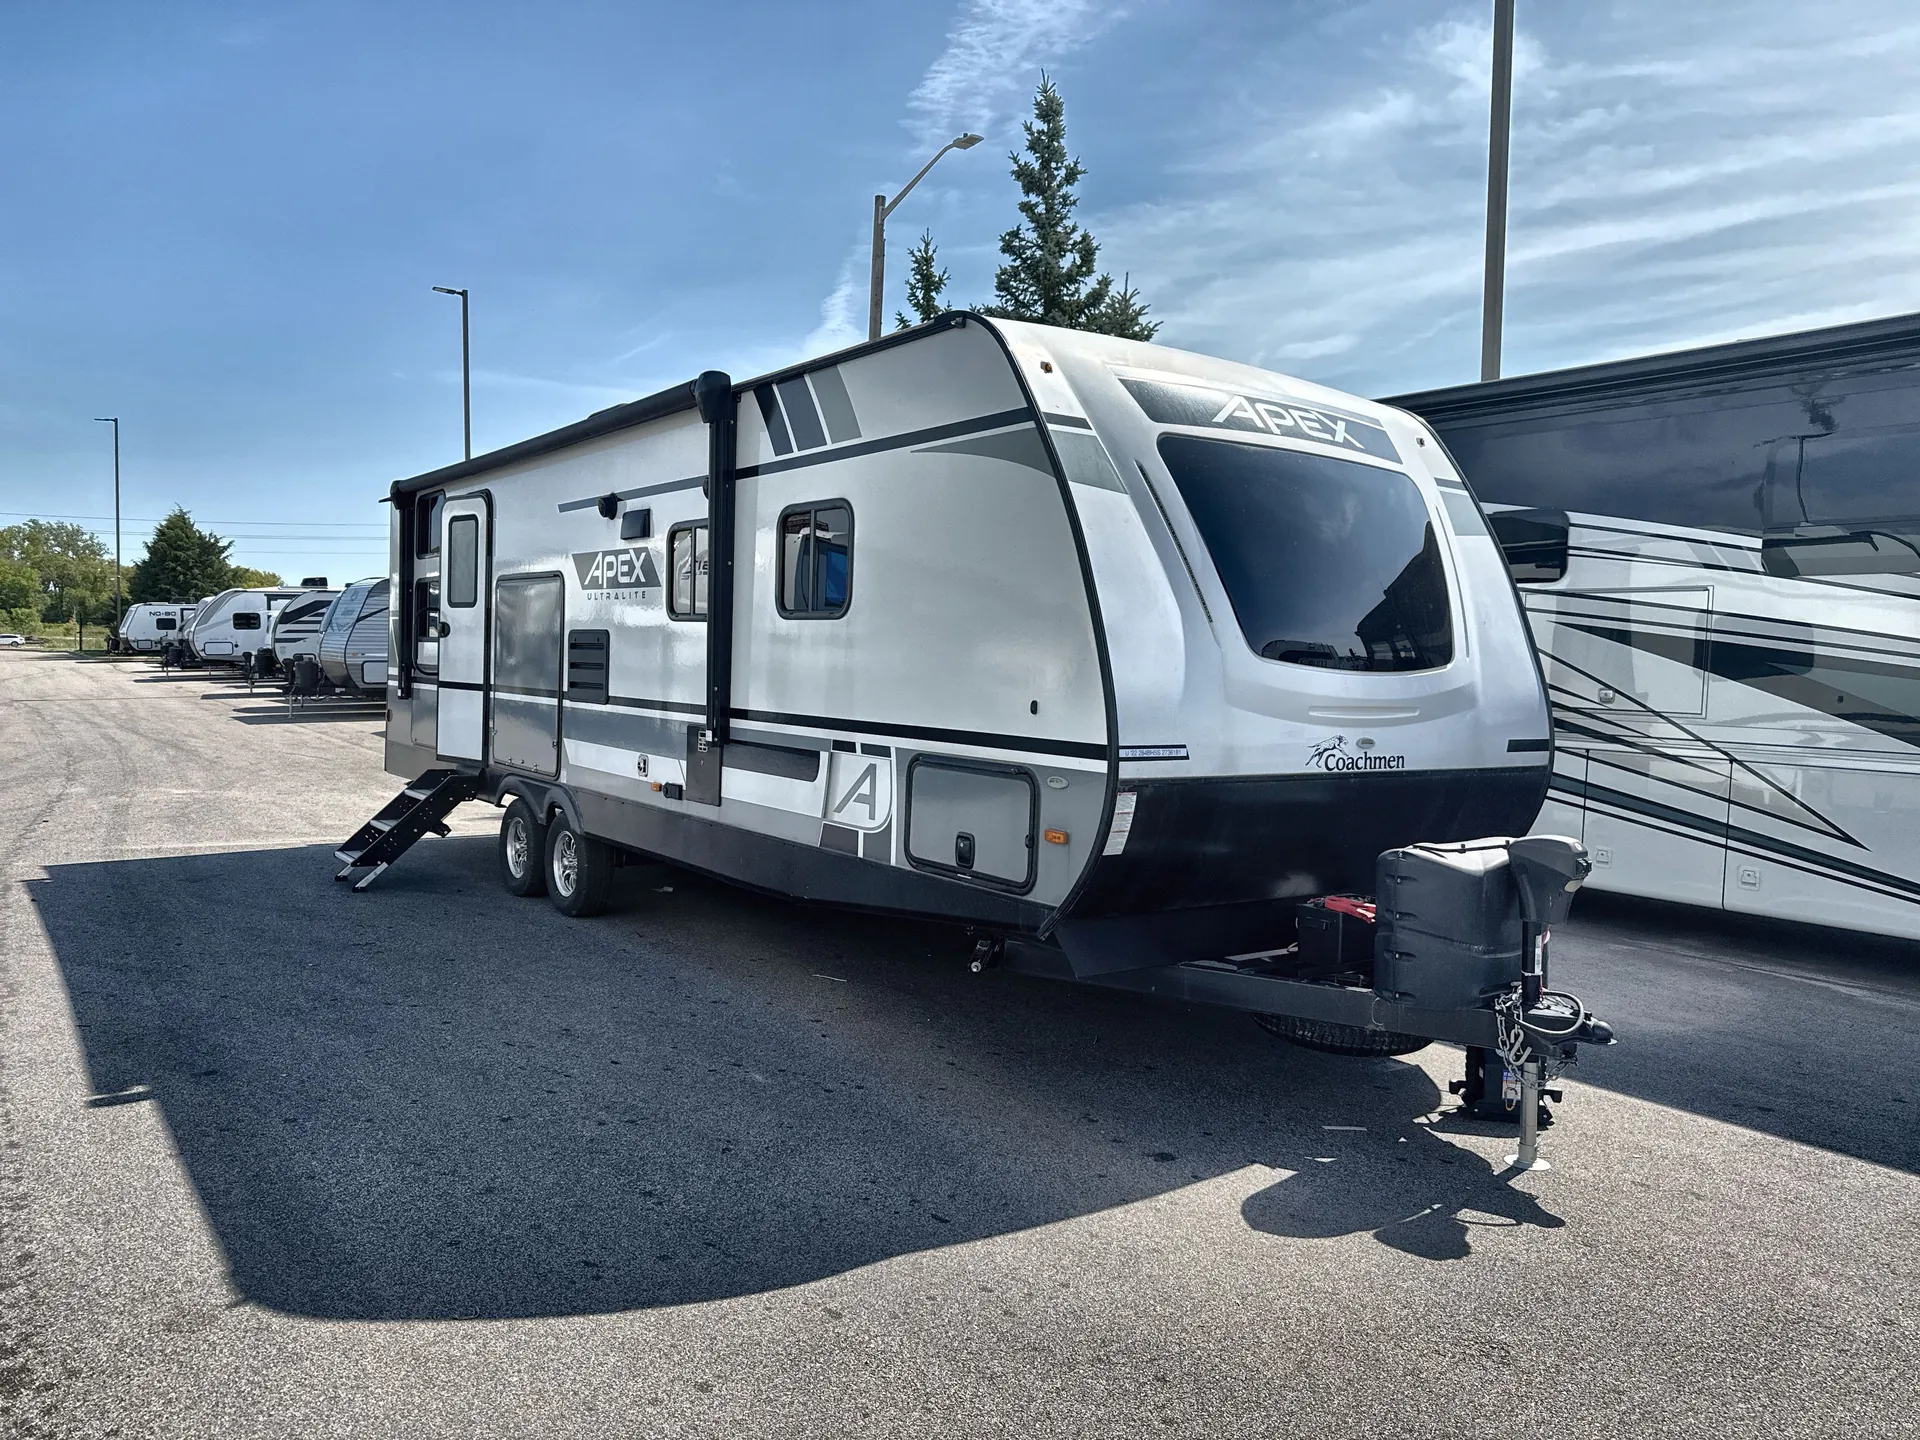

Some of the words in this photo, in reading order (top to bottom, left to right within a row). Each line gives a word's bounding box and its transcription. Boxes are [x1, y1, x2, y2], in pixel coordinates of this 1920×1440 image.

[1211, 394, 1365, 449] APEX
[584, 549, 646, 588] APEX
[587, 590, 646, 600] ULTRALITE
[1324, 751, 1405, 771] Coachmen
[833, 763, 876, 820] A
